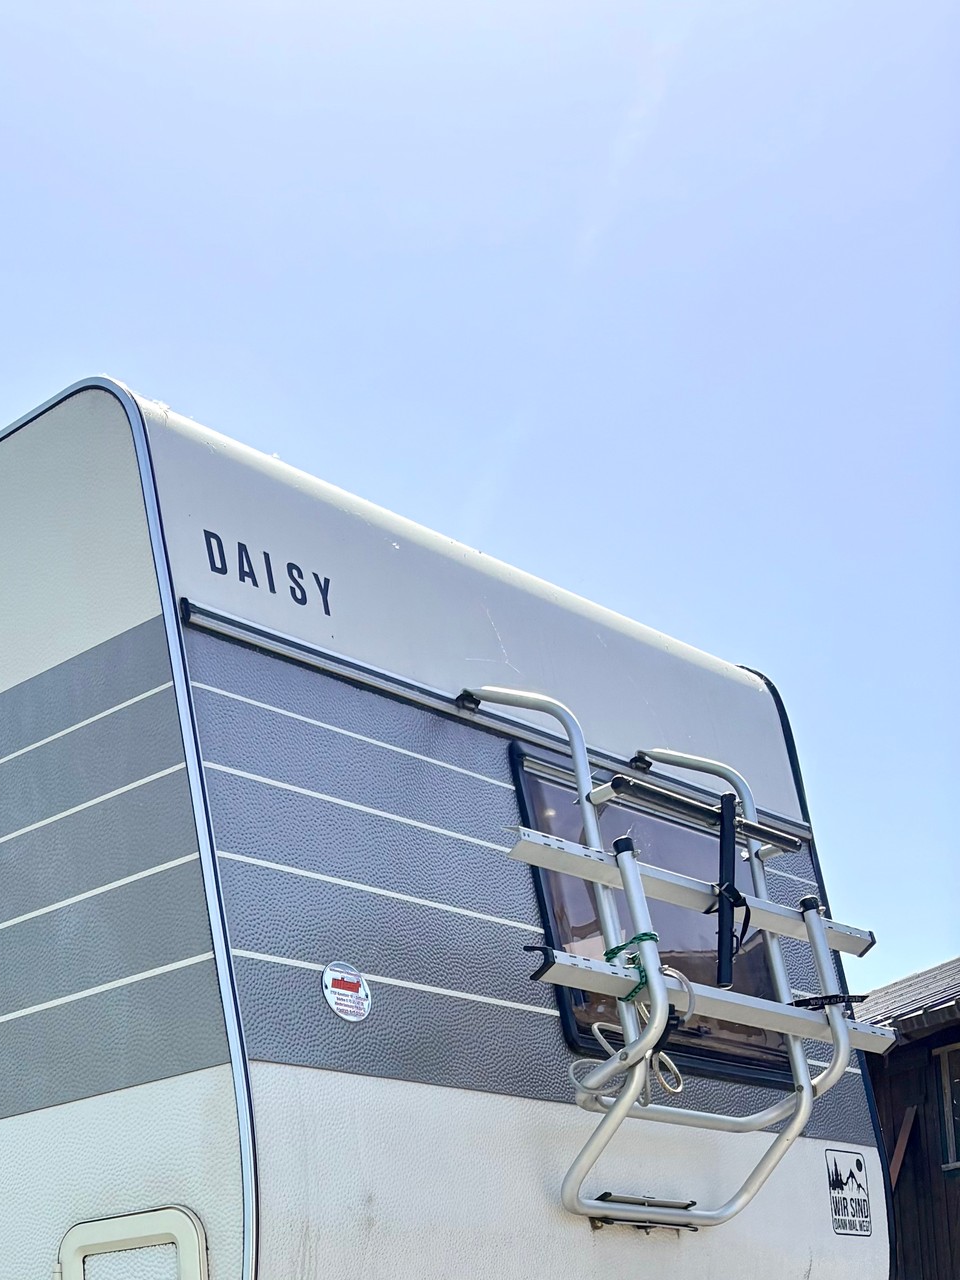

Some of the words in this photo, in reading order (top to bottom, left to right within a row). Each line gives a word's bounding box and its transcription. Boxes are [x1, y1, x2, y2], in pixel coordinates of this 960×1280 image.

[203, 529, 331, 617] DAISY
[832, 1196, 849, 1217] WIR
[850, 1197, 869, 1219] SIND
